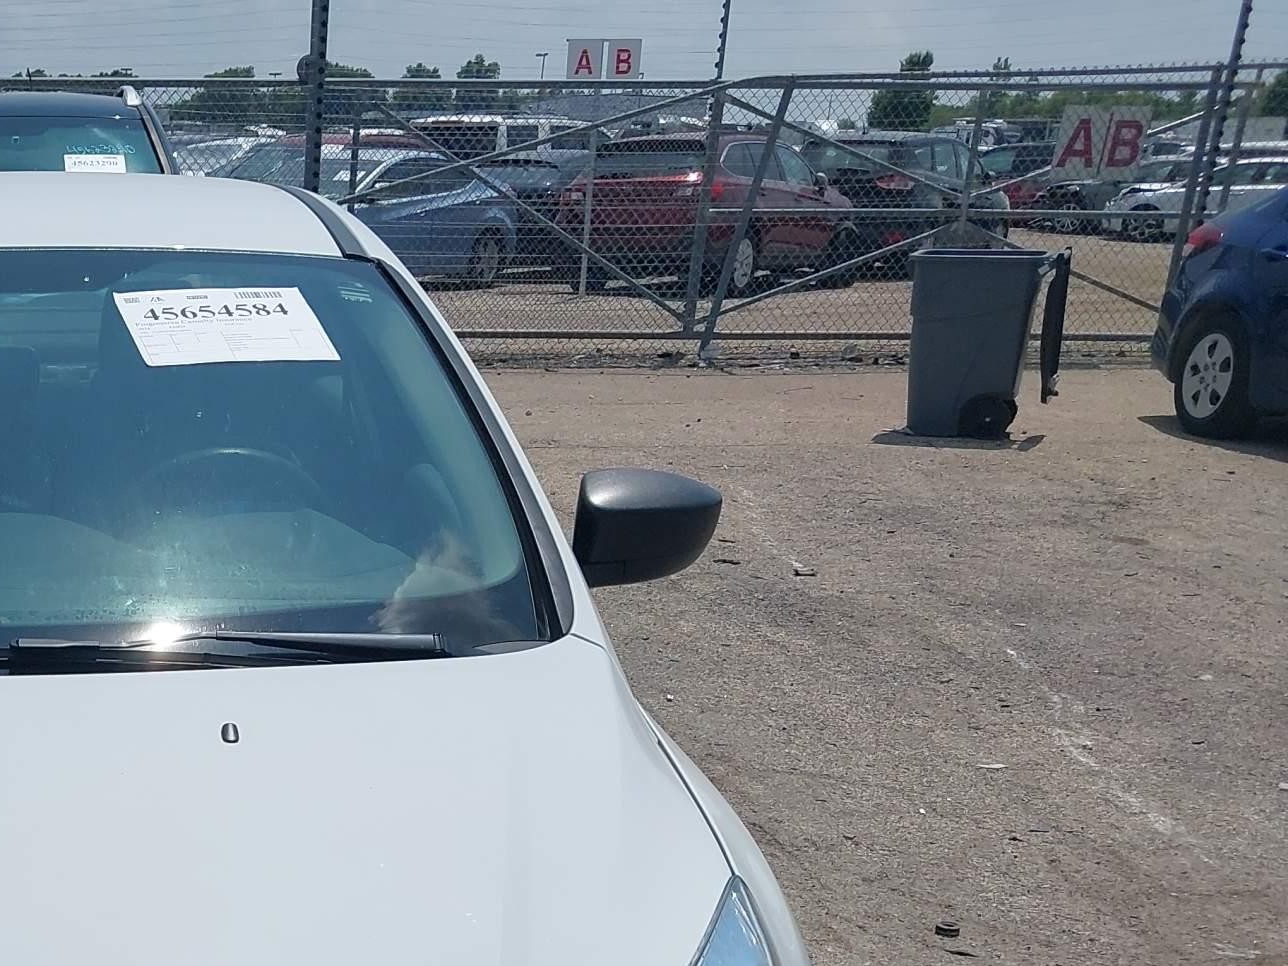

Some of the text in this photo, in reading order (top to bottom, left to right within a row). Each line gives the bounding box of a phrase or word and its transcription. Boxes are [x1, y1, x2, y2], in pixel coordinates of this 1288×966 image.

[574, 49, 632, 75] A B
[143, 302, 289, 321] 45654584
